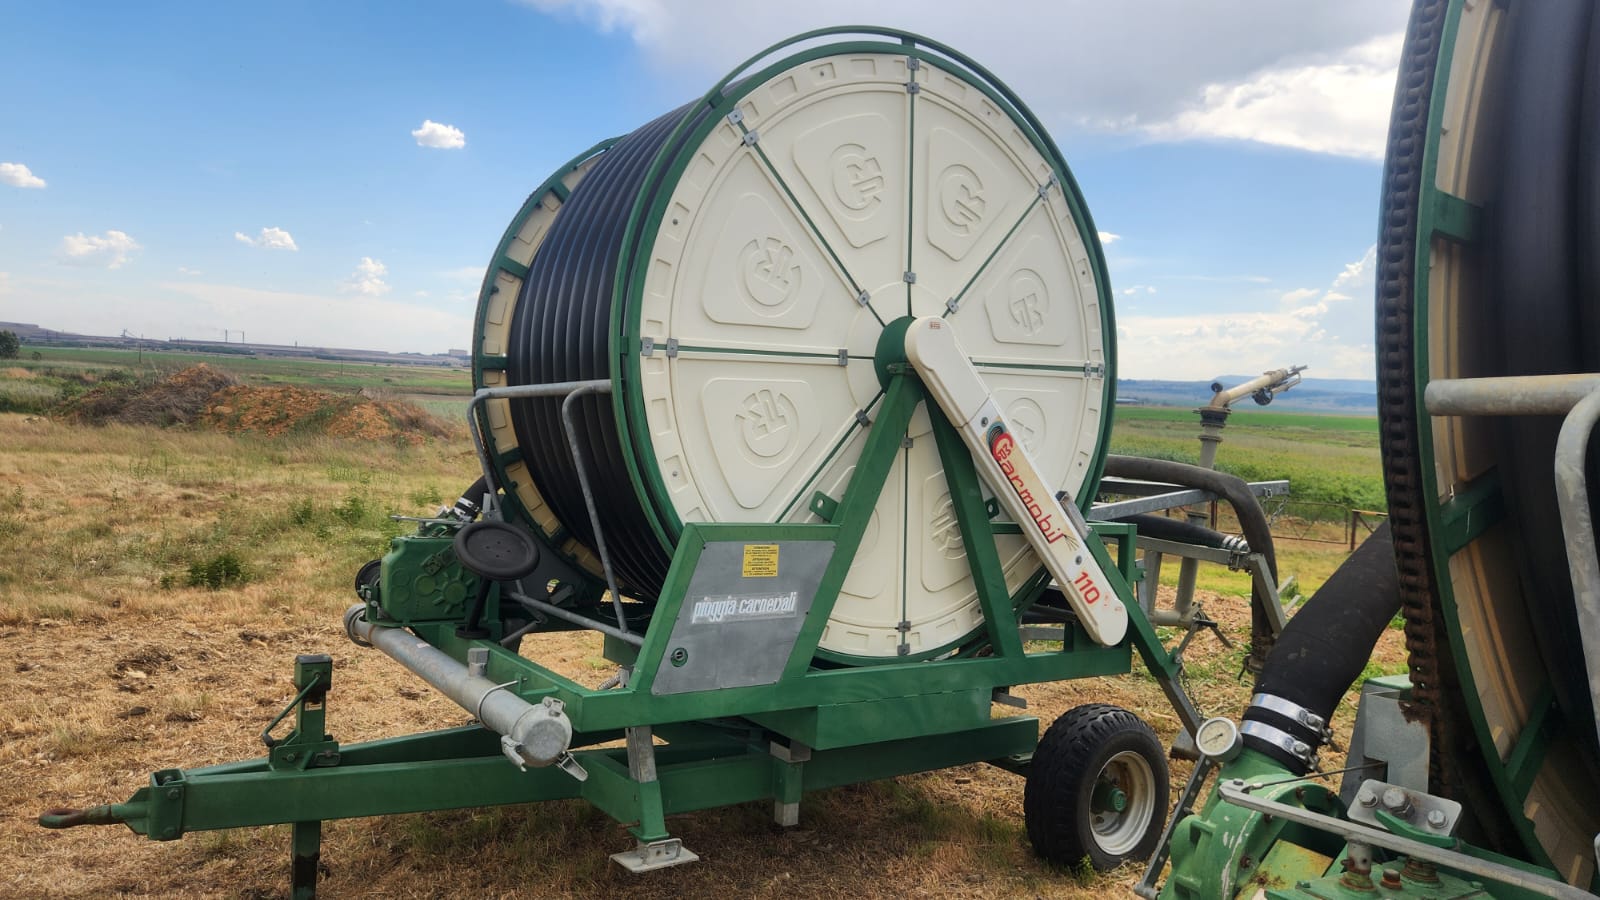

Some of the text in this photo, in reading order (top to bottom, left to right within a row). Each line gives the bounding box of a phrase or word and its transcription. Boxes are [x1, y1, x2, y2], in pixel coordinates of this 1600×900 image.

[1074, 571, 1100, 604] 110
[691, 592, 797, 624] pioggia carnevali
